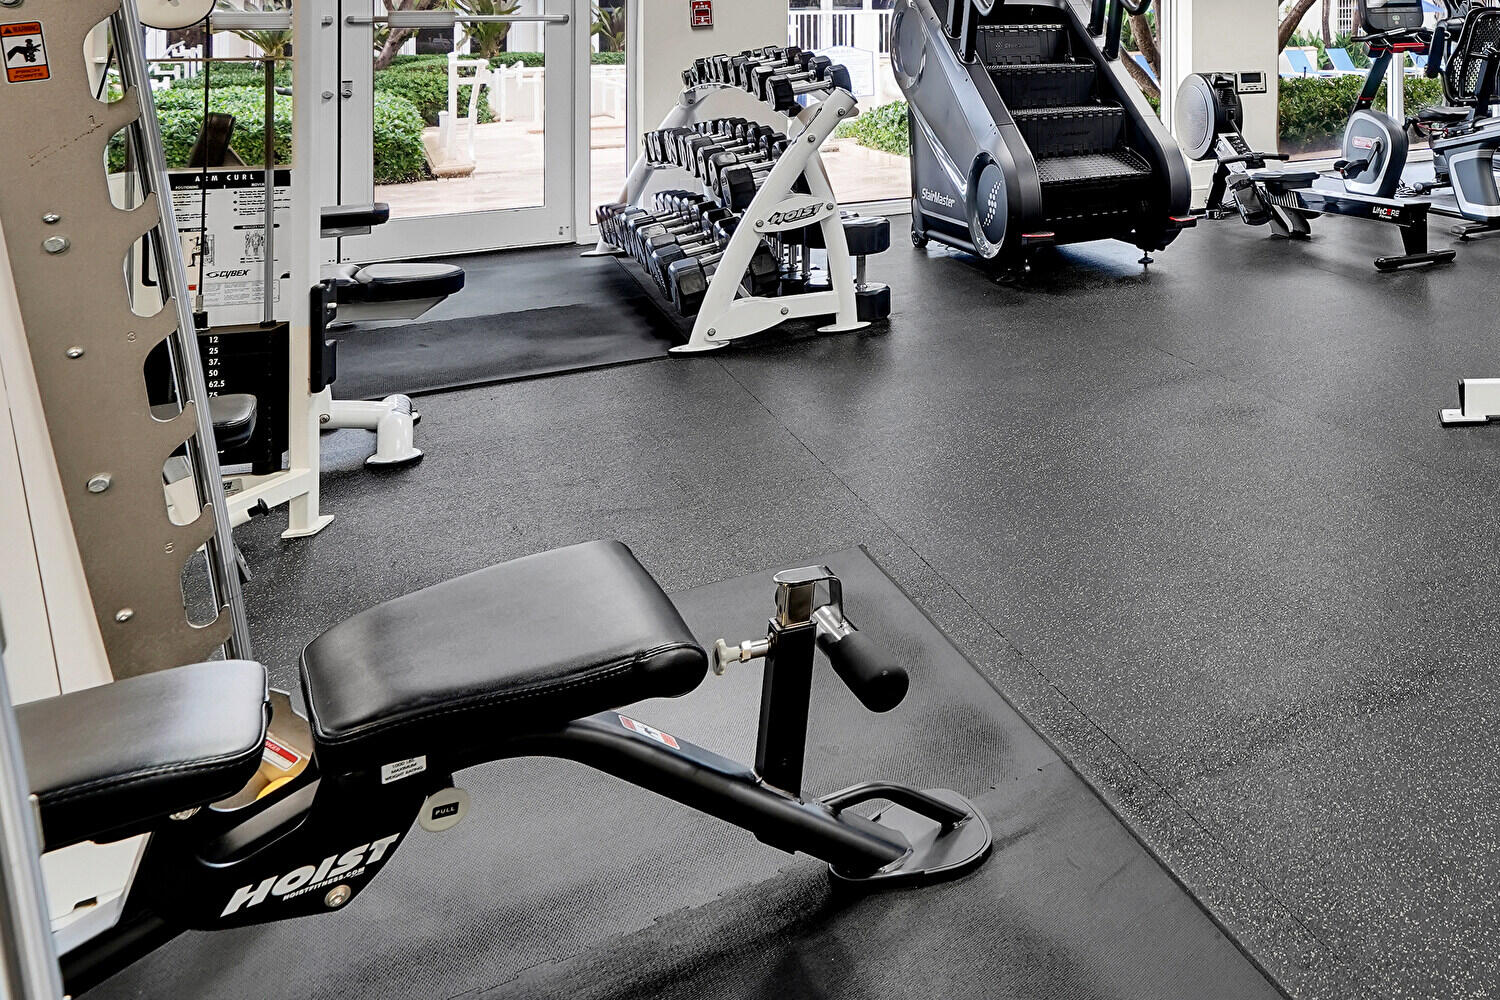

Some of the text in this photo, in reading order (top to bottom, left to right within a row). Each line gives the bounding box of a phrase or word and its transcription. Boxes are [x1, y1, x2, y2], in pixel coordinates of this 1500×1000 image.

[922, 187, 957, 208] StairMaster
[767, 202, 825, 226] HOIST
[219, 269, 250, 278] CYBEX
[209, 336, 219, 344] 12
[209, 347, 219, 355] 25
[209, 369, 219, 377] 50
[208, 380, 225, 388] 62.5
[435, 806, 456, 816] PULL
[220, 833, 400, 918] HOIST
[283, 866, 366, 902] HOISTFITNESS.COM
